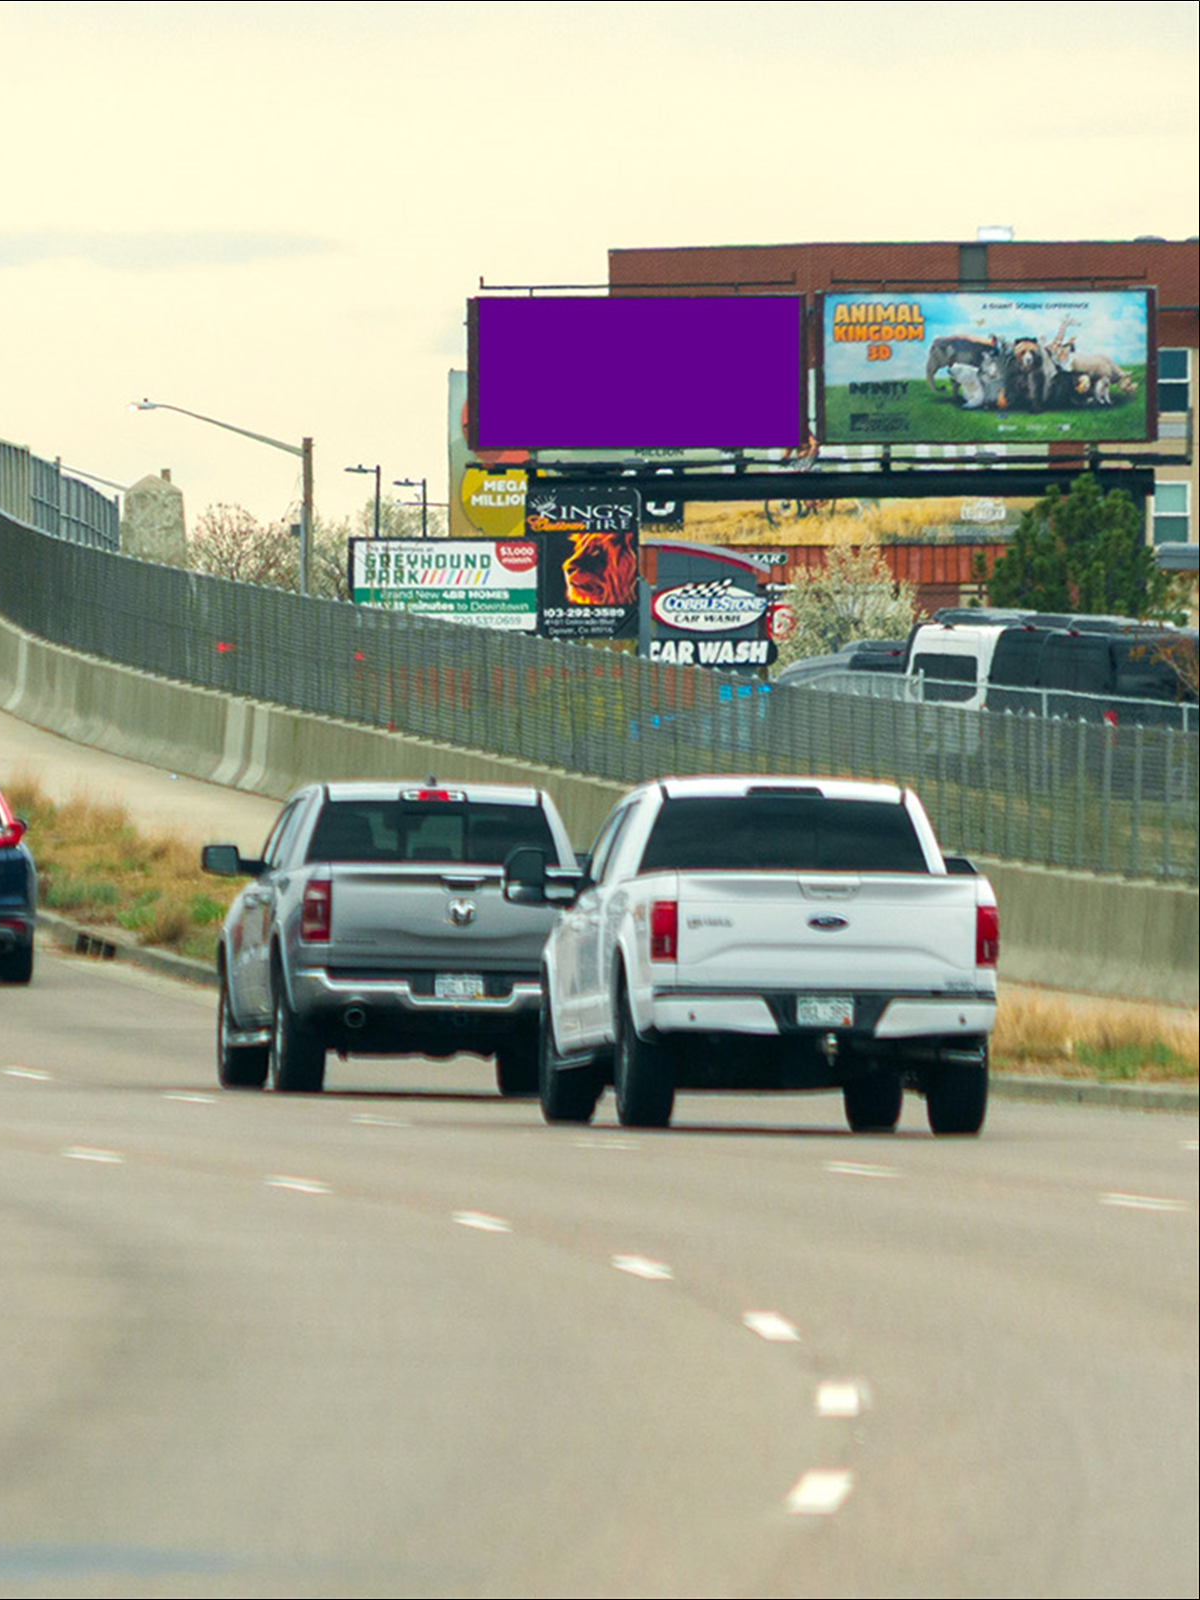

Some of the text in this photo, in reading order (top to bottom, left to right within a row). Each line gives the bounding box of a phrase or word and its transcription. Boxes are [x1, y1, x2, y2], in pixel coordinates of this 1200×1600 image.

[833, 303, 925, 324] ANIMAL
[833, 324, 925, 343] KINGDOM
[866, 343, 893, 362] 3D
[848, 381, 909, 395] INFINITY
[483, 480, 527, 493] MEGA
[537, 503, 633, 520] KING'S
[583, 519, 630, 531] TIRE
[365, 553, 491, 569] GREYHOUND
[364, 569, 419, 585] PARK
[468, 590, 510, 600] HOMES
[456, 603, 468, 611] to
[470, 601, 530, 612] Downtown
[664, 594, 768, 613] COBBLESTONE
[675, 614, 741, 623] CAR WASH
[650, 640, 769, 664] CAR WASH
